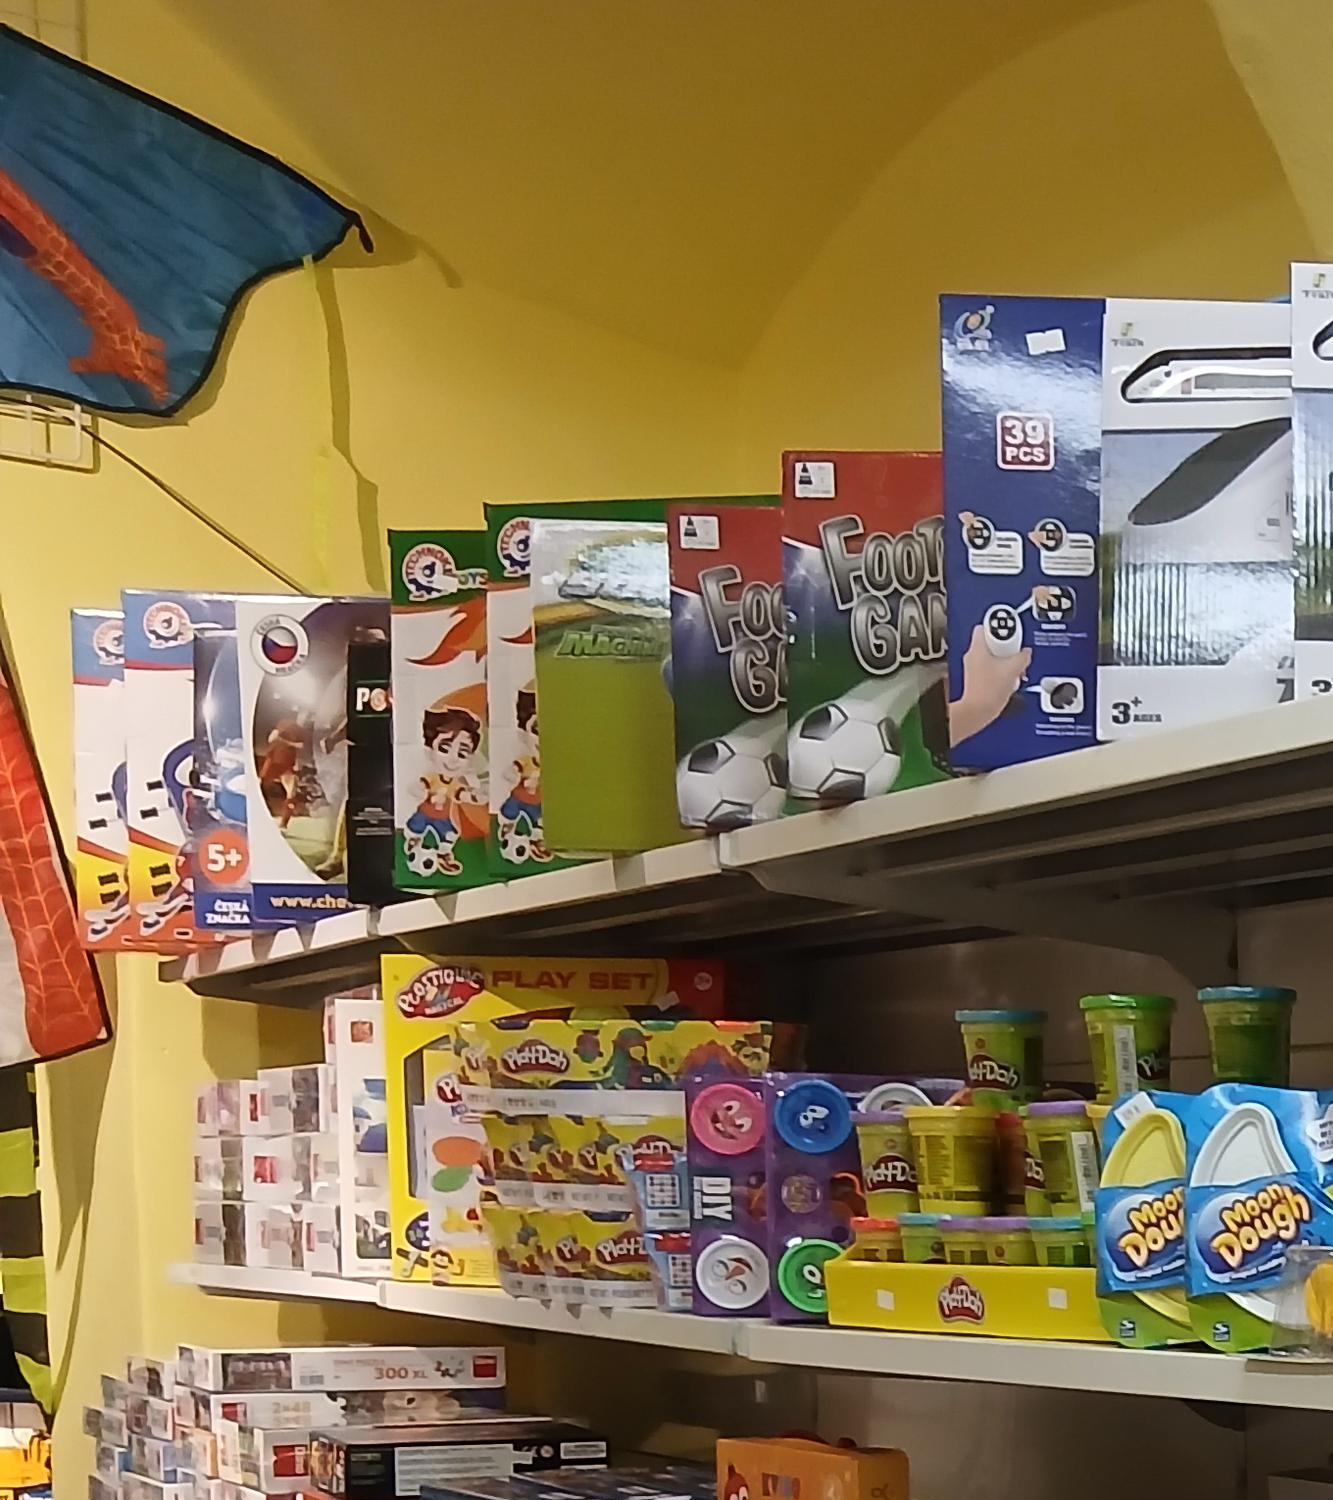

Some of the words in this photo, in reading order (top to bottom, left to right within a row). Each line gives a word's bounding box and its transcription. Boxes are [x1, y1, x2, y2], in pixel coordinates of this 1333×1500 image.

[1004, 418, 1046, 445] 39
[1004, 446, 1046, 463] PCS
[206, 843, 243, 873] 5+
[492, 969, 578, 991] PLAY
[587, 971, 653, 991] SET
[702, 1175, 733, 1221] DIY
[1221, 1181, 1288, 1232] Moon
[1118, 1209, 1185, 1269] Dou
[1210, 1186, 1311, 1270] Dough
[374, 1366, 409, 1380] 300
